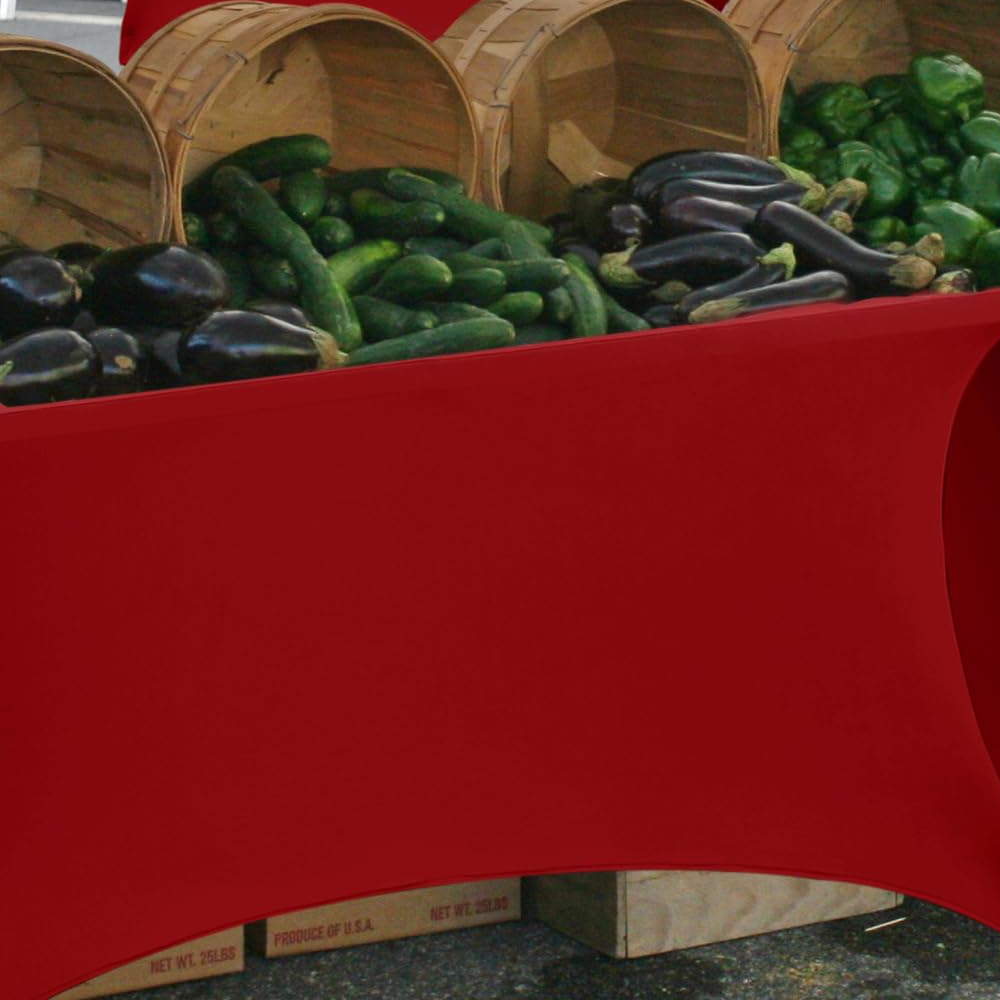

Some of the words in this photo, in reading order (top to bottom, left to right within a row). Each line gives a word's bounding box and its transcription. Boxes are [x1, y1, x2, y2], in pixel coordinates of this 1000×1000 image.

[273, 926, 325, 948] PRODUCE
[327, 922, 342, 939] OF
[430, 904, 451, 921] NET
[150, 956, 173, 975] NET
[175, 951, 197, 969] WT.
[199, 945, 236, 966] 25LBS
